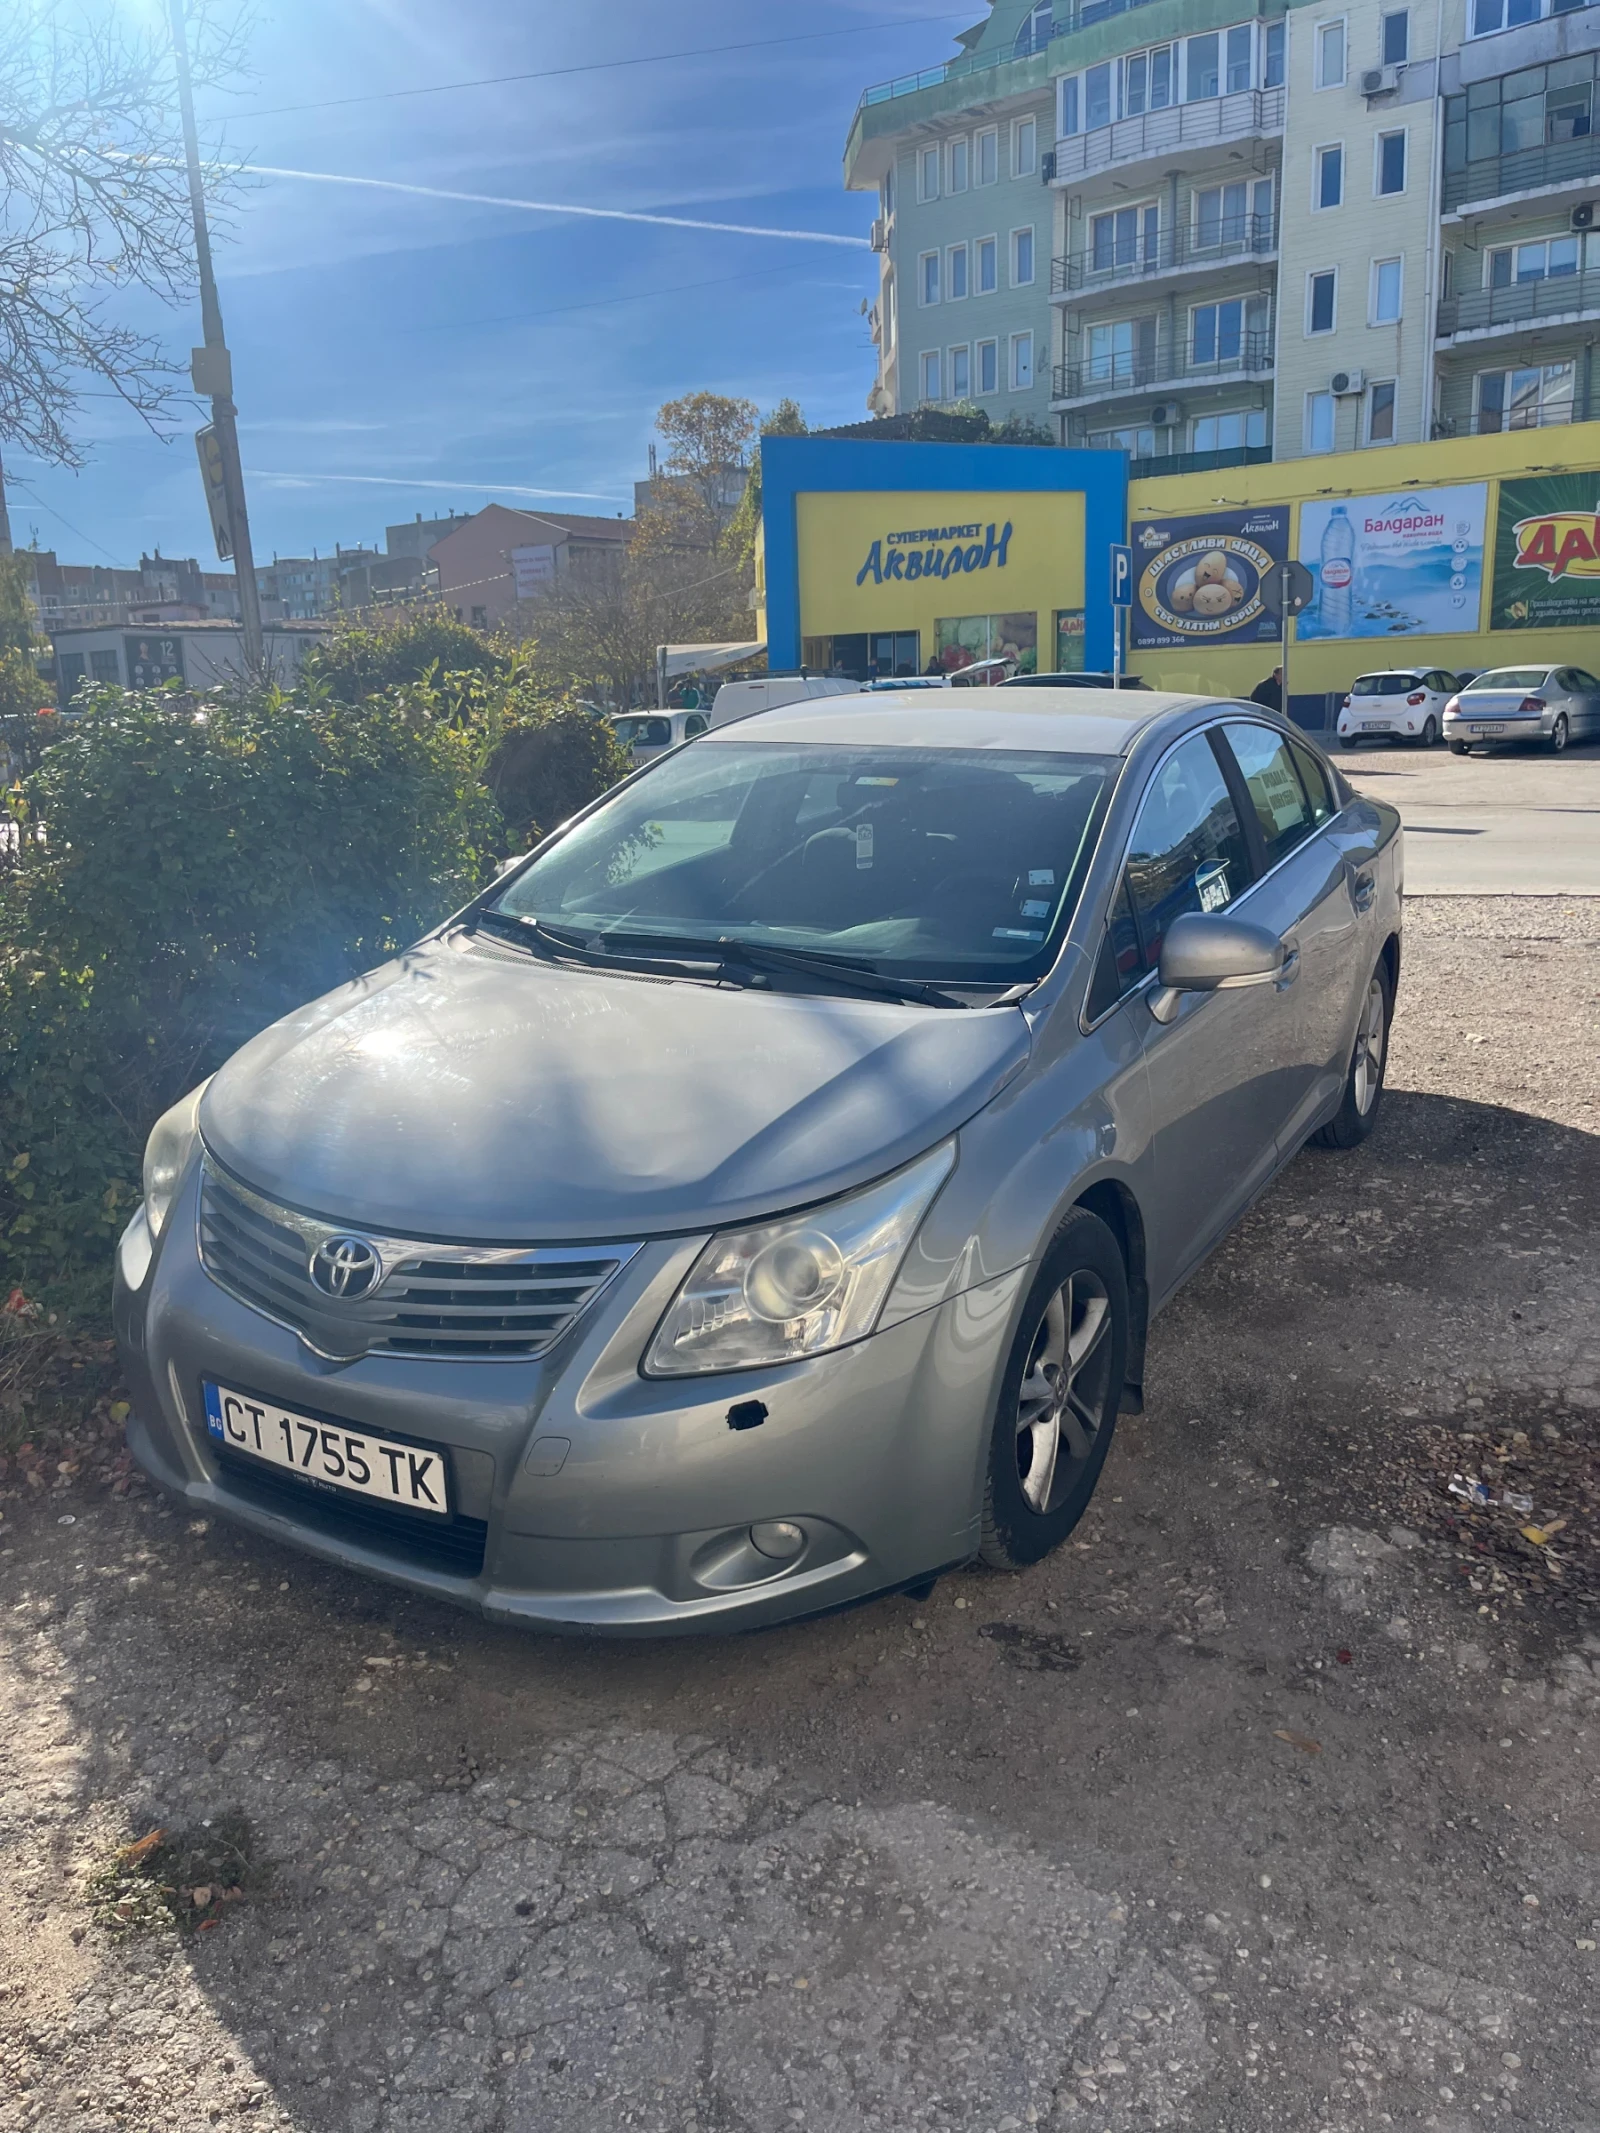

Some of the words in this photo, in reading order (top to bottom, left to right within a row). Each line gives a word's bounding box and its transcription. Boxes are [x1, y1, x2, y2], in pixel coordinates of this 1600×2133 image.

[887, 523, 983, 545] СУПЕРМАРКЕТ
[1363, 514, 1444, 534] Балдаран
[1149, 538, 1226, 578] ЩАСТЛИВИ
[1230, 539, 1269, 568] ЯЙЦА
[1516, 515, 1600, 577] ДА
[1116, 553, 1128, 598] P
[1154, 607, 1174, 624] СЪС
[1176, 618, 1220, 632] ЗЛАТНИ
[1224, 599, 1262, 627] СЪРЦА
[159, 641, 173, 656] 12
[1138, 637, 1156, 646] 0899
[1156, 636, 1170, 645] 899
[1171, 635, 1185, 644] 366
[209, 1413, 223, 1431] BG
[224, 1396, 265, 1450] CT
[279, 1418, 371, 1485] 1755
[378, 1446, 439, 1504] TK
